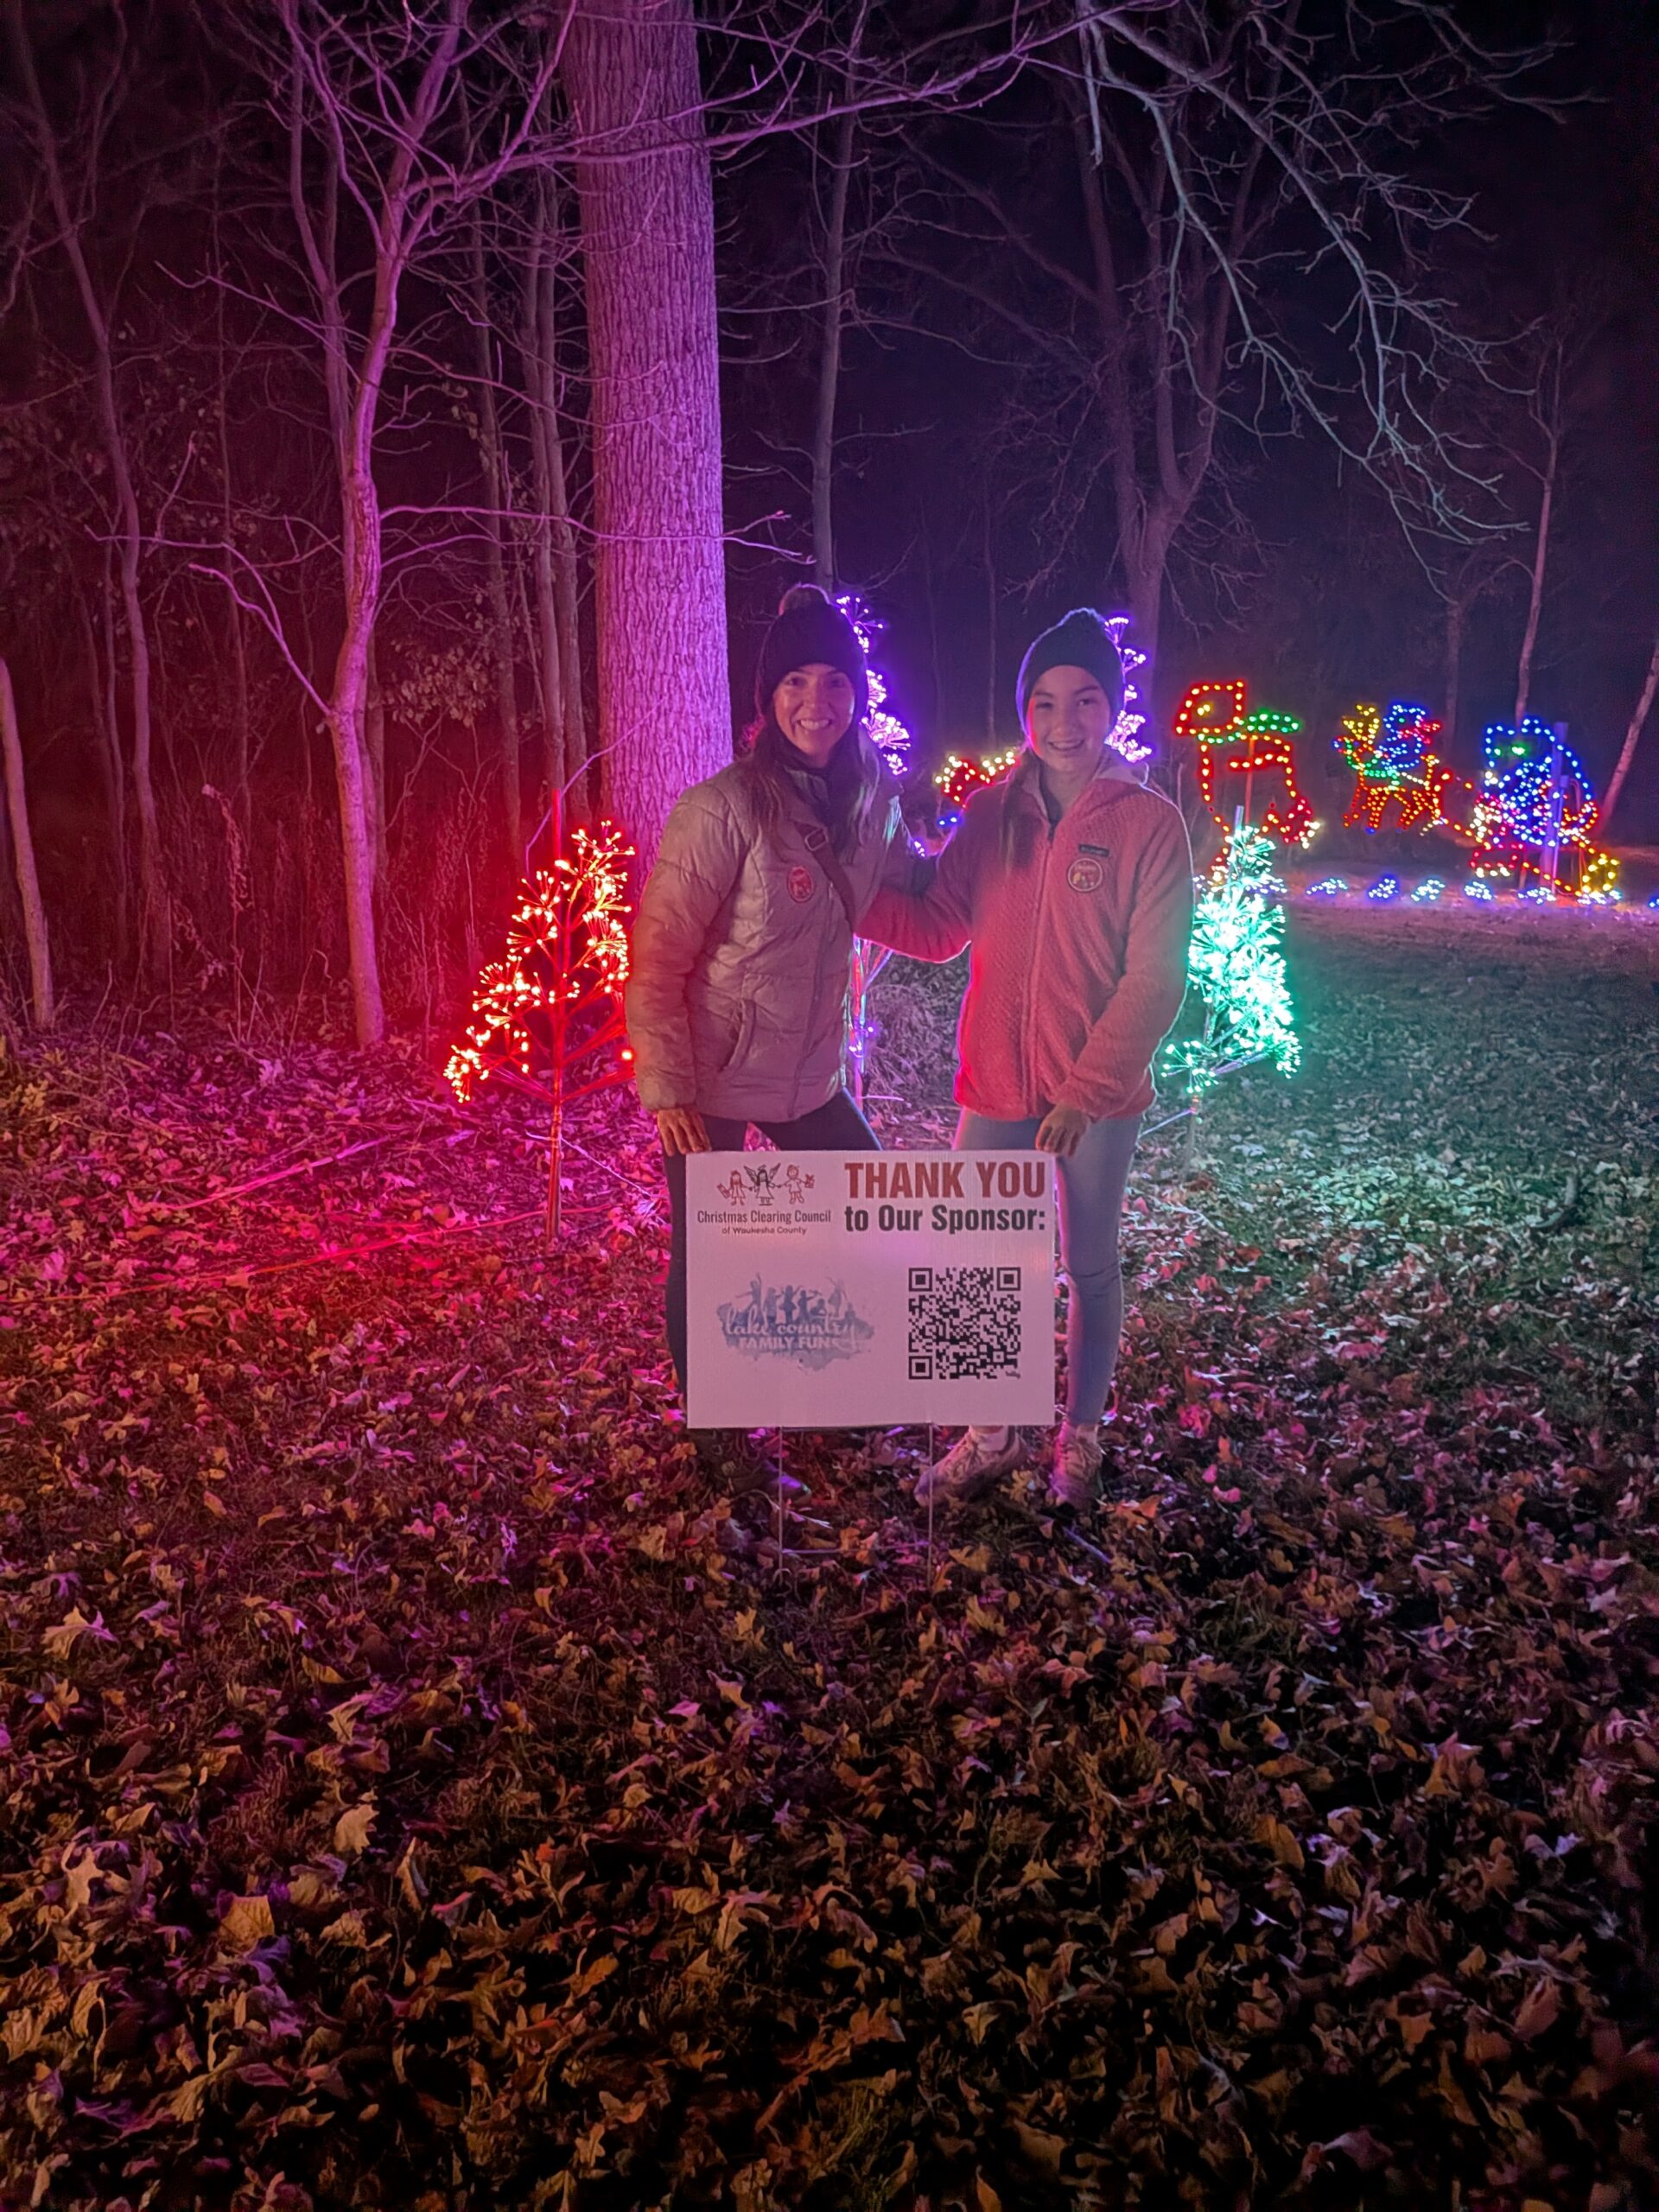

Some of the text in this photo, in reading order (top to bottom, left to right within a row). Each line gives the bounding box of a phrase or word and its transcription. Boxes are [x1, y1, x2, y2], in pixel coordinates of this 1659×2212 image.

[844, 1160, 1046, 1199] THANK YOU
[697, 1210, 831, 1224] Christmas Clearing Council
[844, 1205, 1046, 1235] to Our Sponsor:
[777, 1226, 807, 1236] County
[739, 1337, 830, 1350] FAMILY FUN
